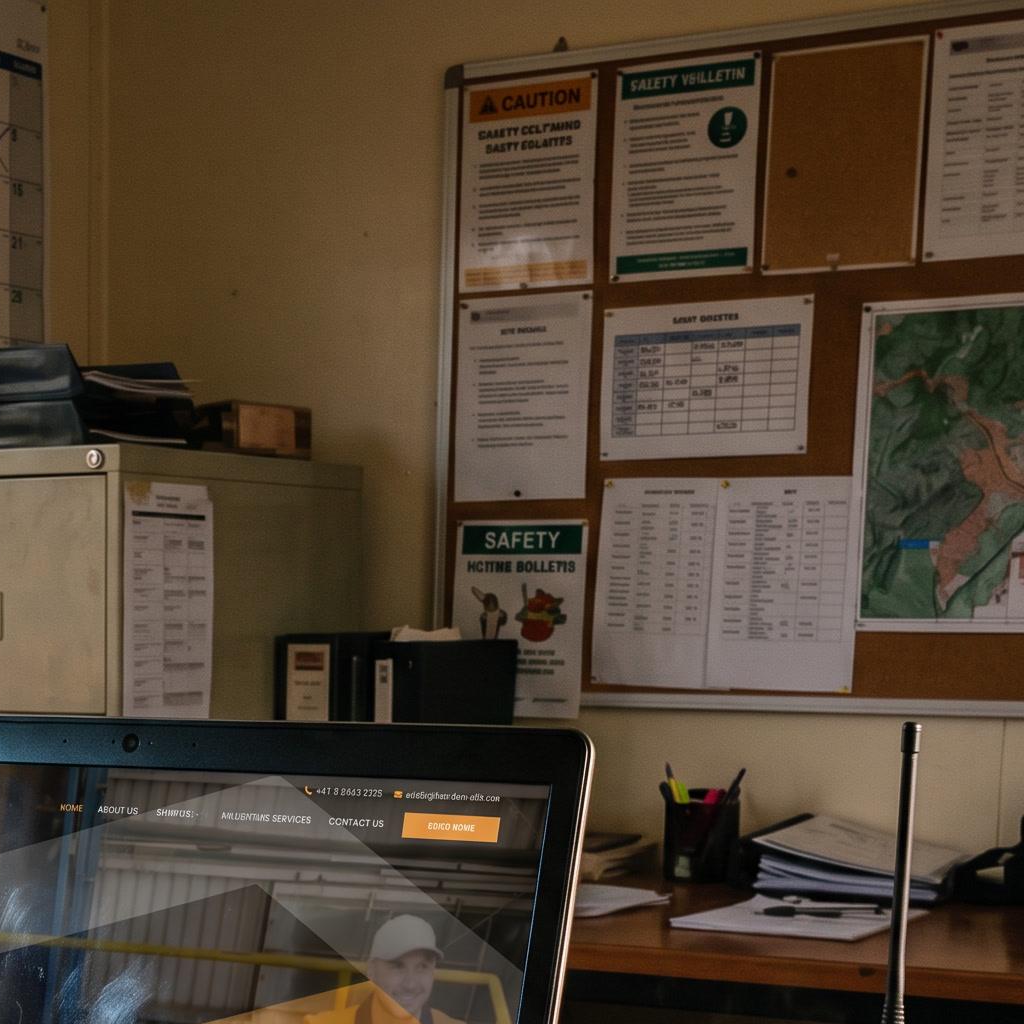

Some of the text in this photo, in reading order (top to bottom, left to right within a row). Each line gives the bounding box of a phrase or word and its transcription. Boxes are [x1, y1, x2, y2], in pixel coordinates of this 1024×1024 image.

[501, 88, 581, 112] CAUTION
[484, 531, 561, 550] SAFETY
[97, 805, 125, 815] ABOUT
[126, 806, 140, 816] US
[272, 814, 312, 825] SERVICES
[328, 816, 369, 827] CONTACT
[370, 817, 384, 828] US
